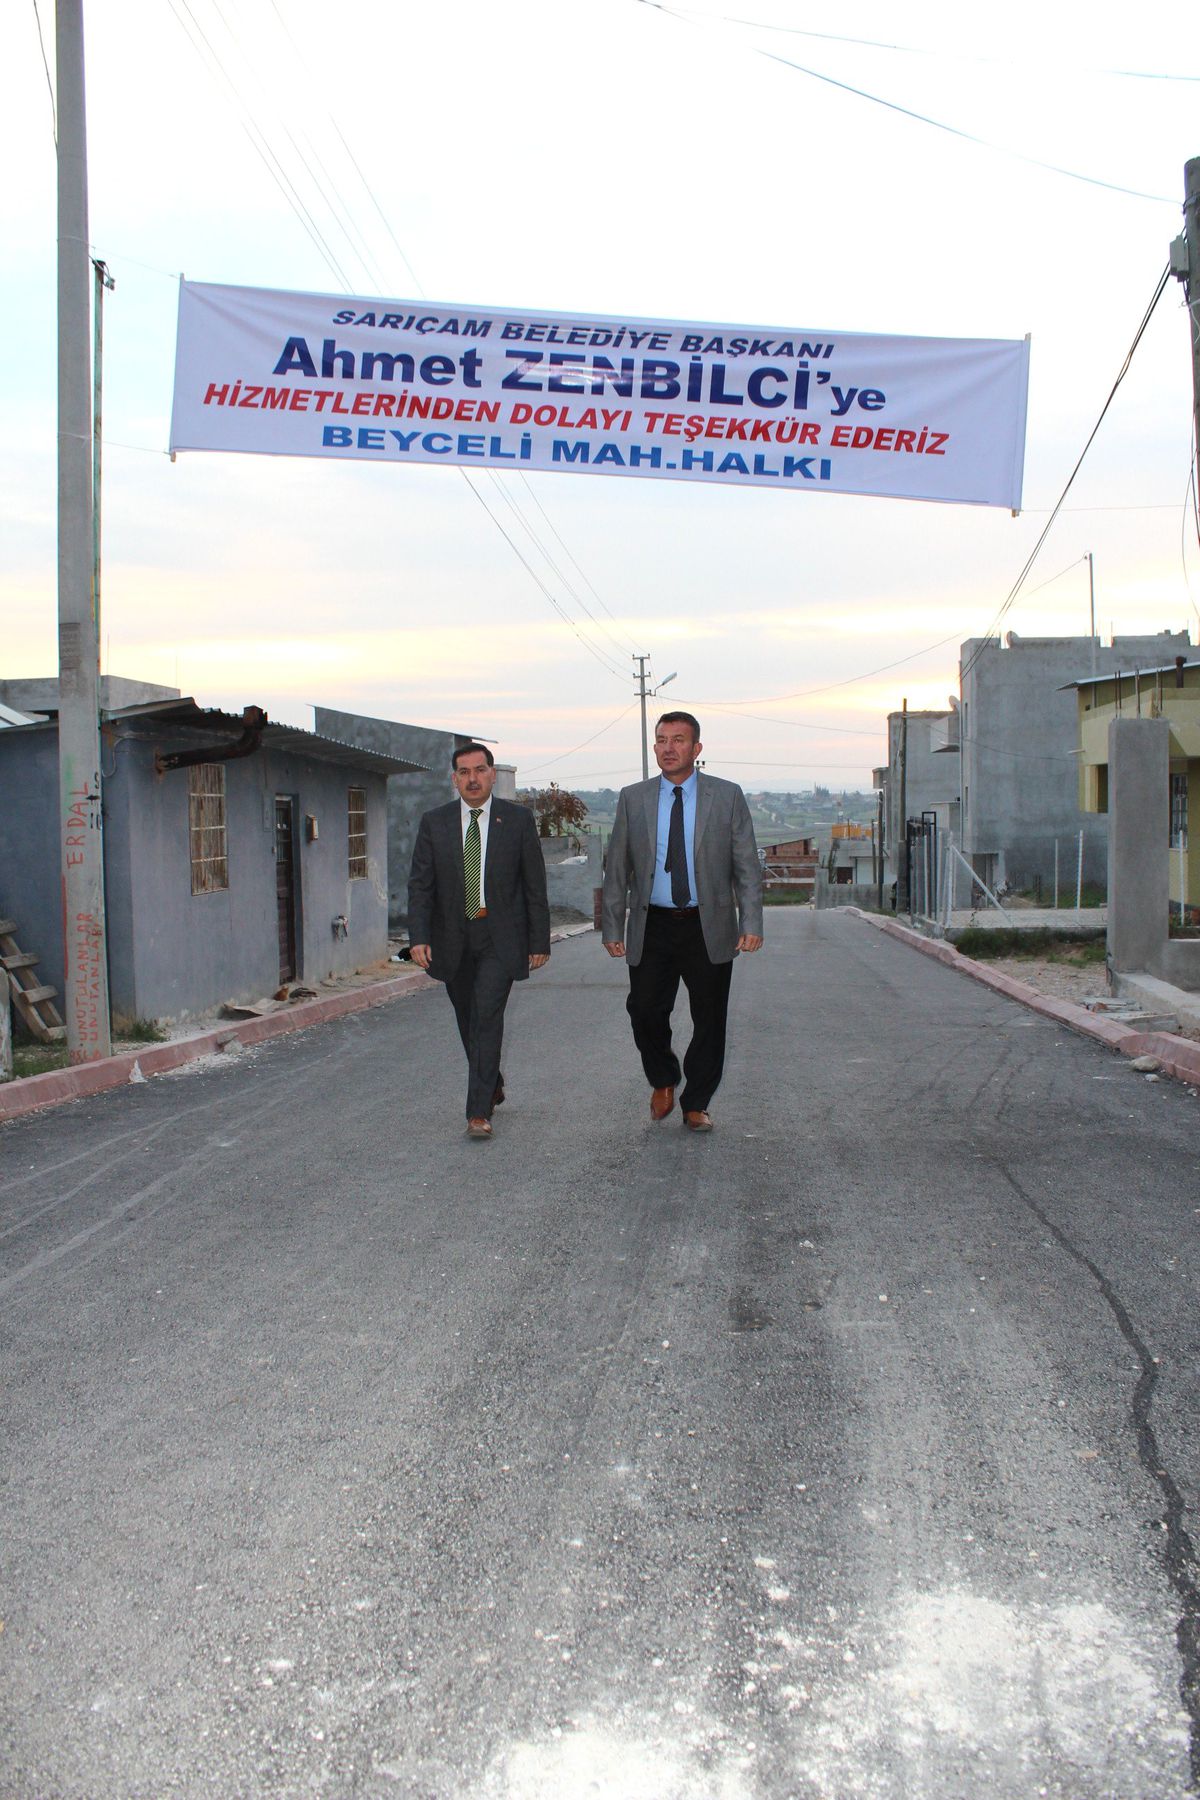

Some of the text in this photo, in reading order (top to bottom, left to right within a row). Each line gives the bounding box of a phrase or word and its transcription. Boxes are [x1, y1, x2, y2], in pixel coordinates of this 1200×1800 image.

[272, 336, 483, 388] Ahmet
[332, 310, 834, 359] SARIÇAM BELEDİYE BAŞKANI
[203, 379, 950, 455] HİZMETLERİNDEN DOLAYI TEŞEKKÜR EDERİZ
[322, 425, 832, 480] BEYCELİ MAH.HALKI
[65, 782, 89, 868] ERDAL
